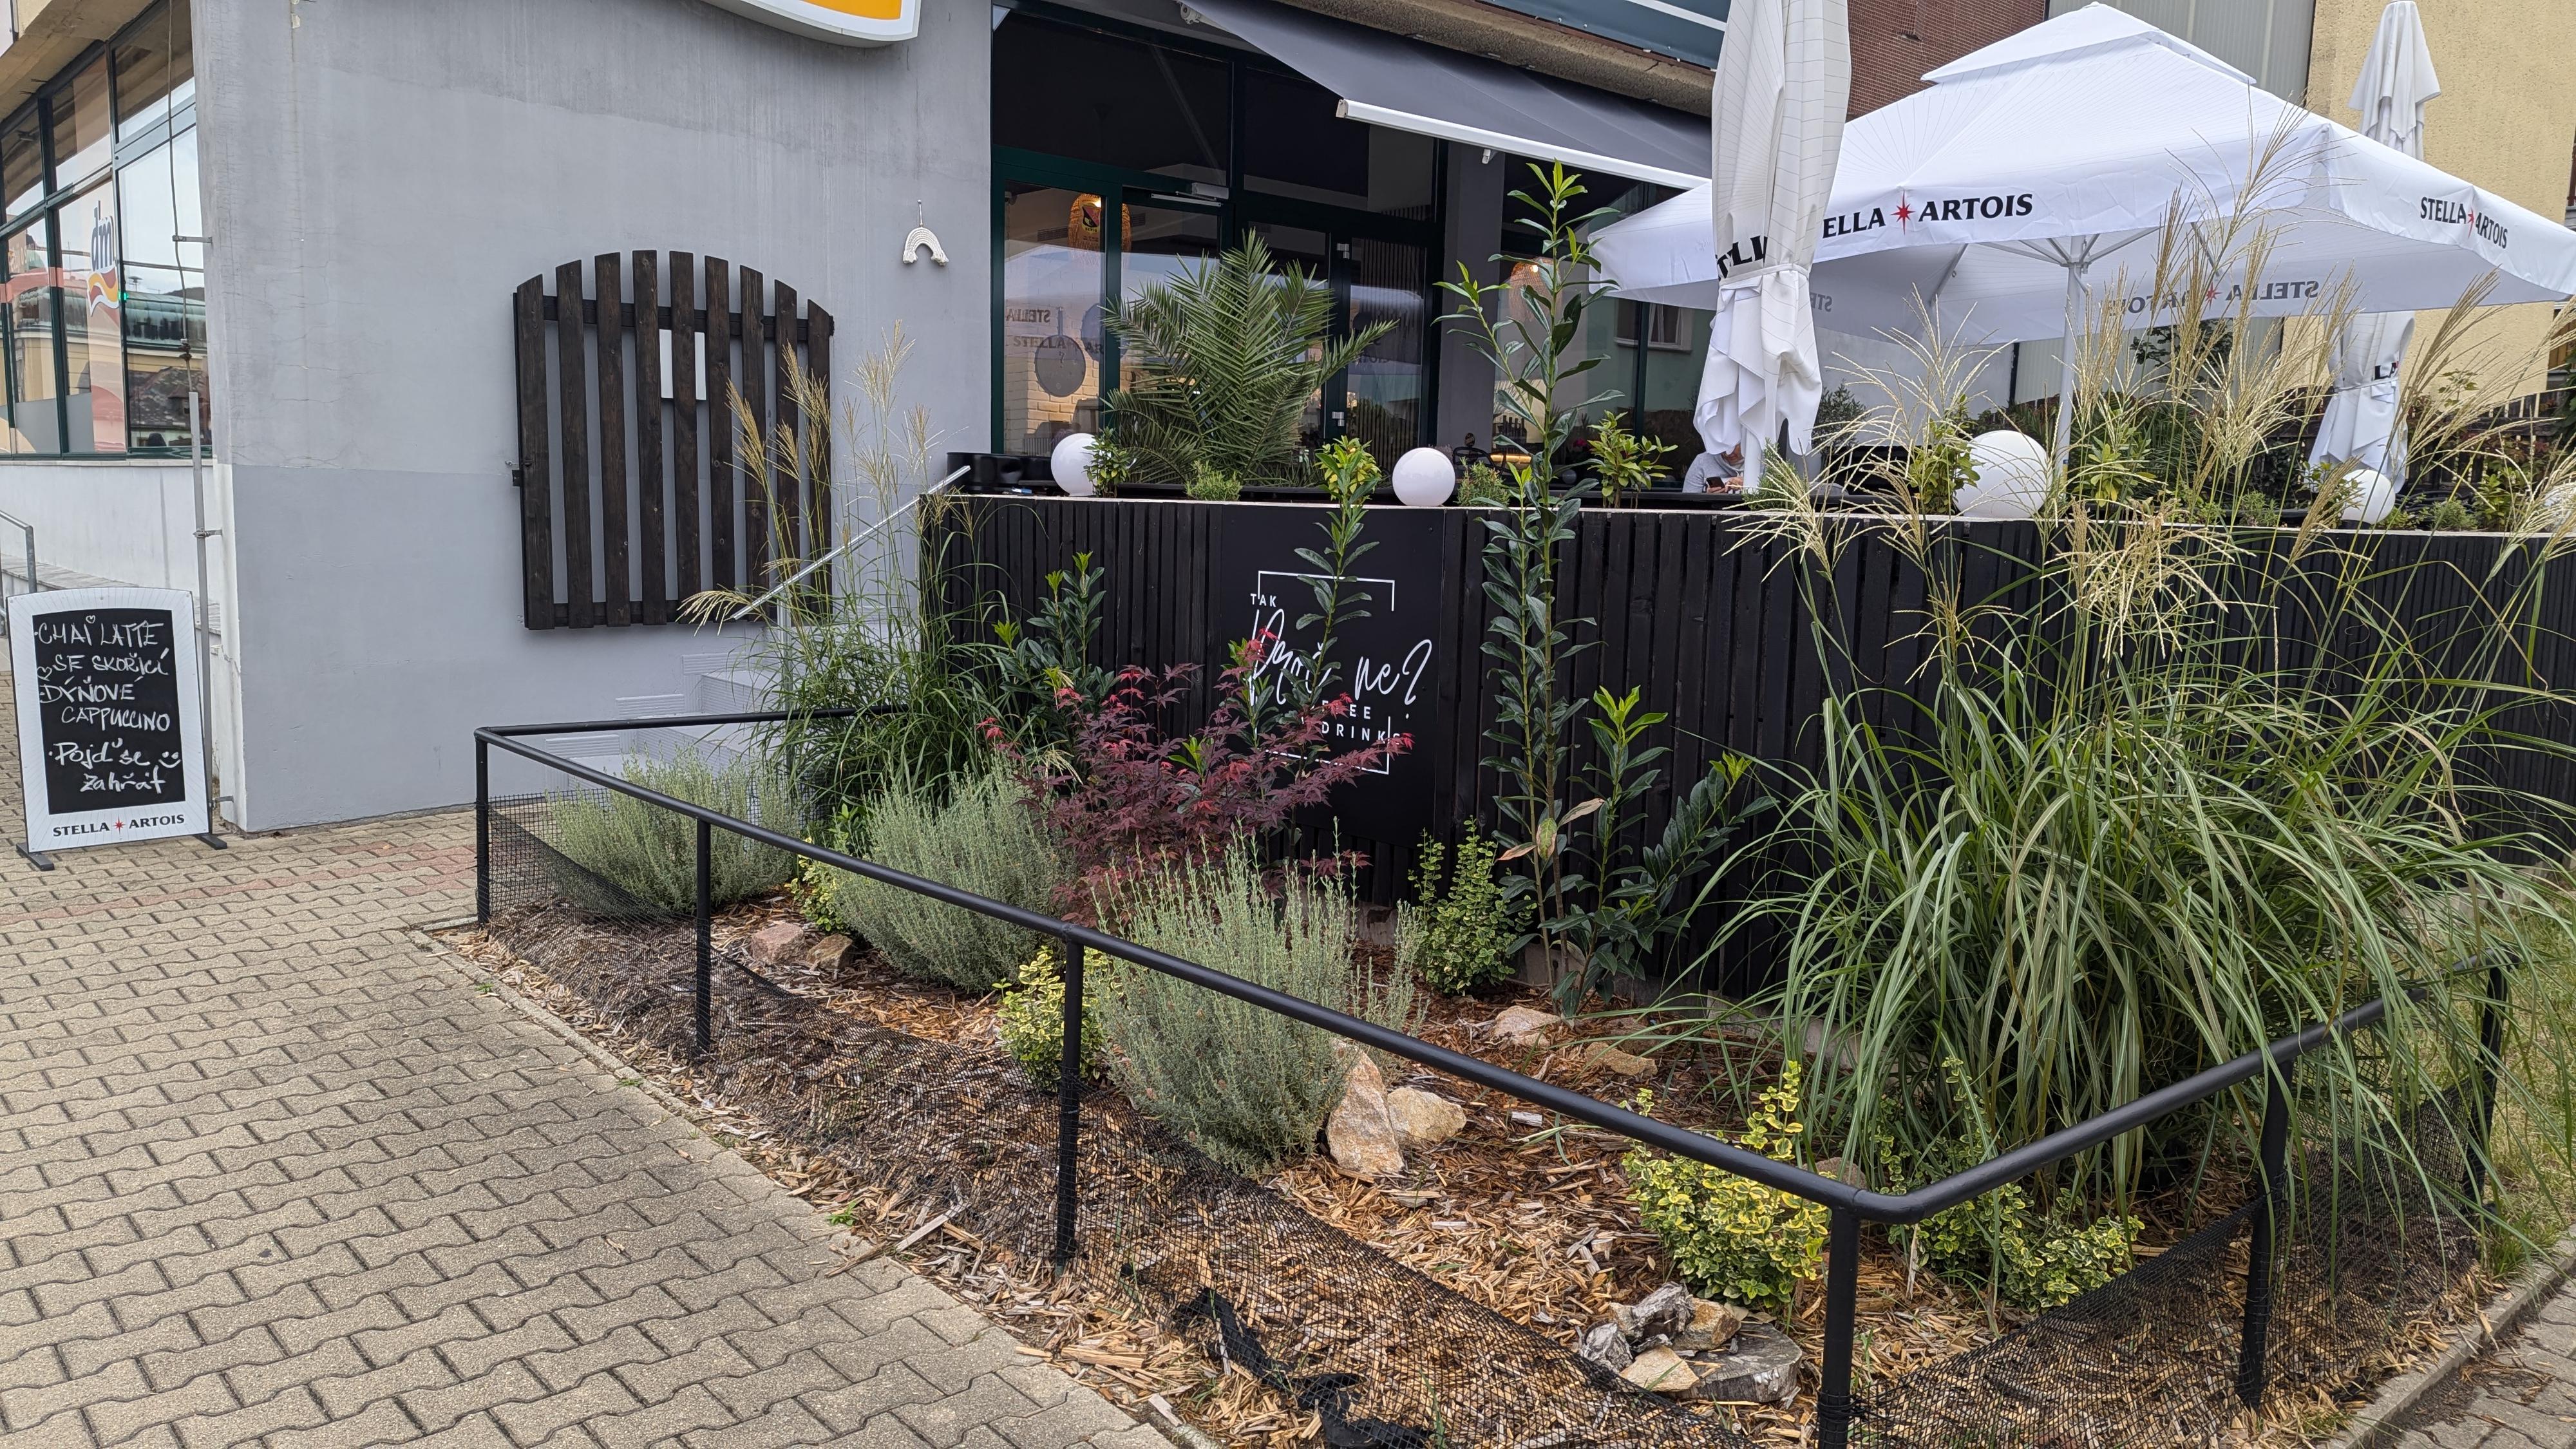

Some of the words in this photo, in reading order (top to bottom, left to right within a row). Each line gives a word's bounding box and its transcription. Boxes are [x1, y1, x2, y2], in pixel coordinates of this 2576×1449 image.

[1822, 207, 1886, 239] ELLA
[1918, 193, 2033, 223] ARTOIS
[2420, 196, 2467, 224] STELLA
[2475, 212, 2508, 249] ARTOIS
[1250, 593, 1277, 608] TAK
[39, 616, 94, 646] CHAI
[100, 620, 164, 648] LATTE
[53, 654, 85, 672] SE
[61, 706, 171, 732] CAPPUCCINO
[53, 822, 110, 837] STELLA
[128, 814, 185, 829] ARTOIS
